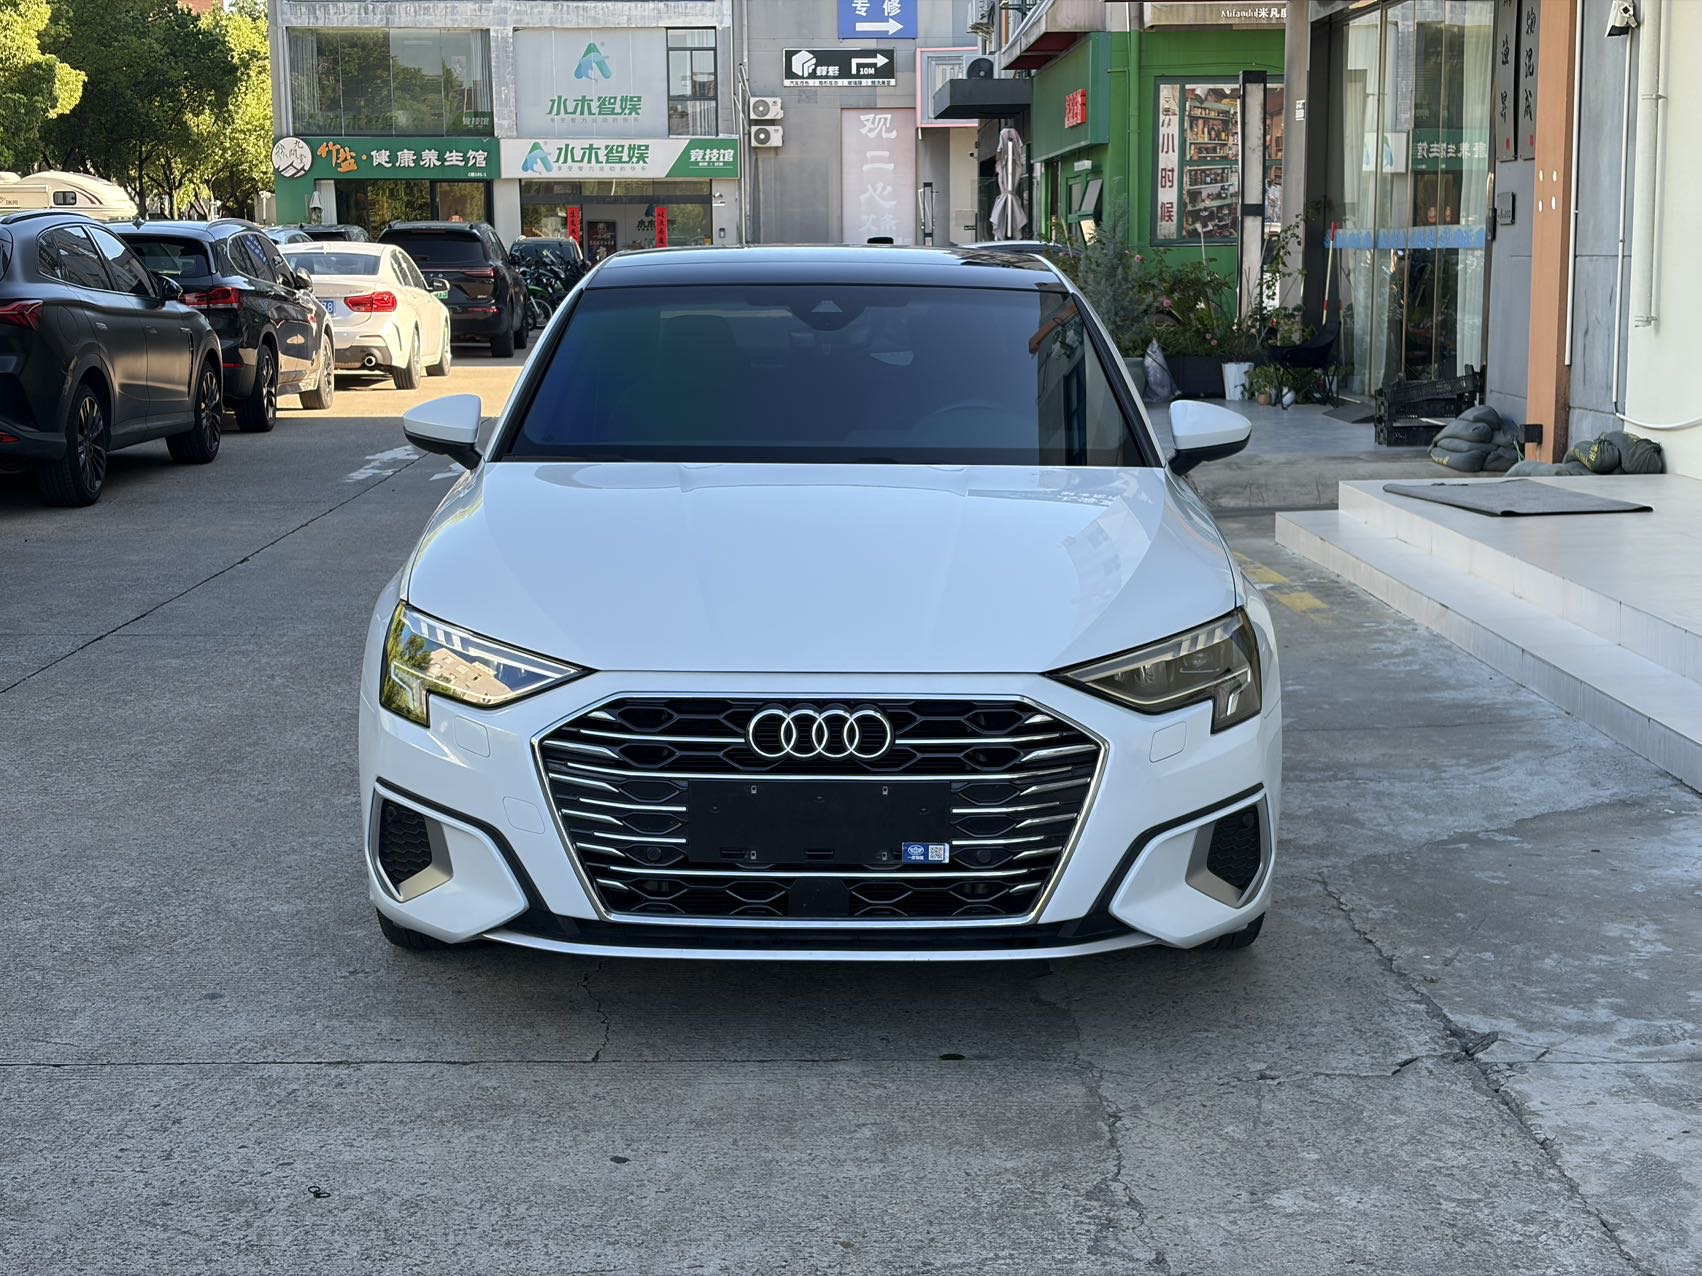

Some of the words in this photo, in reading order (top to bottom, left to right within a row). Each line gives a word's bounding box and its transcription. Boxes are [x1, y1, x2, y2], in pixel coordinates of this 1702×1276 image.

[852, 0, 901, 17] 专修
[859, 67, 875, 75] 10M
[545, 95, 642, 116] 水木智娱
[370, 148, 488, 168] 健康养生馆
[553, 143, 650, 164] 水木智娱
[689, 148, 734, 162] 竞技馆
